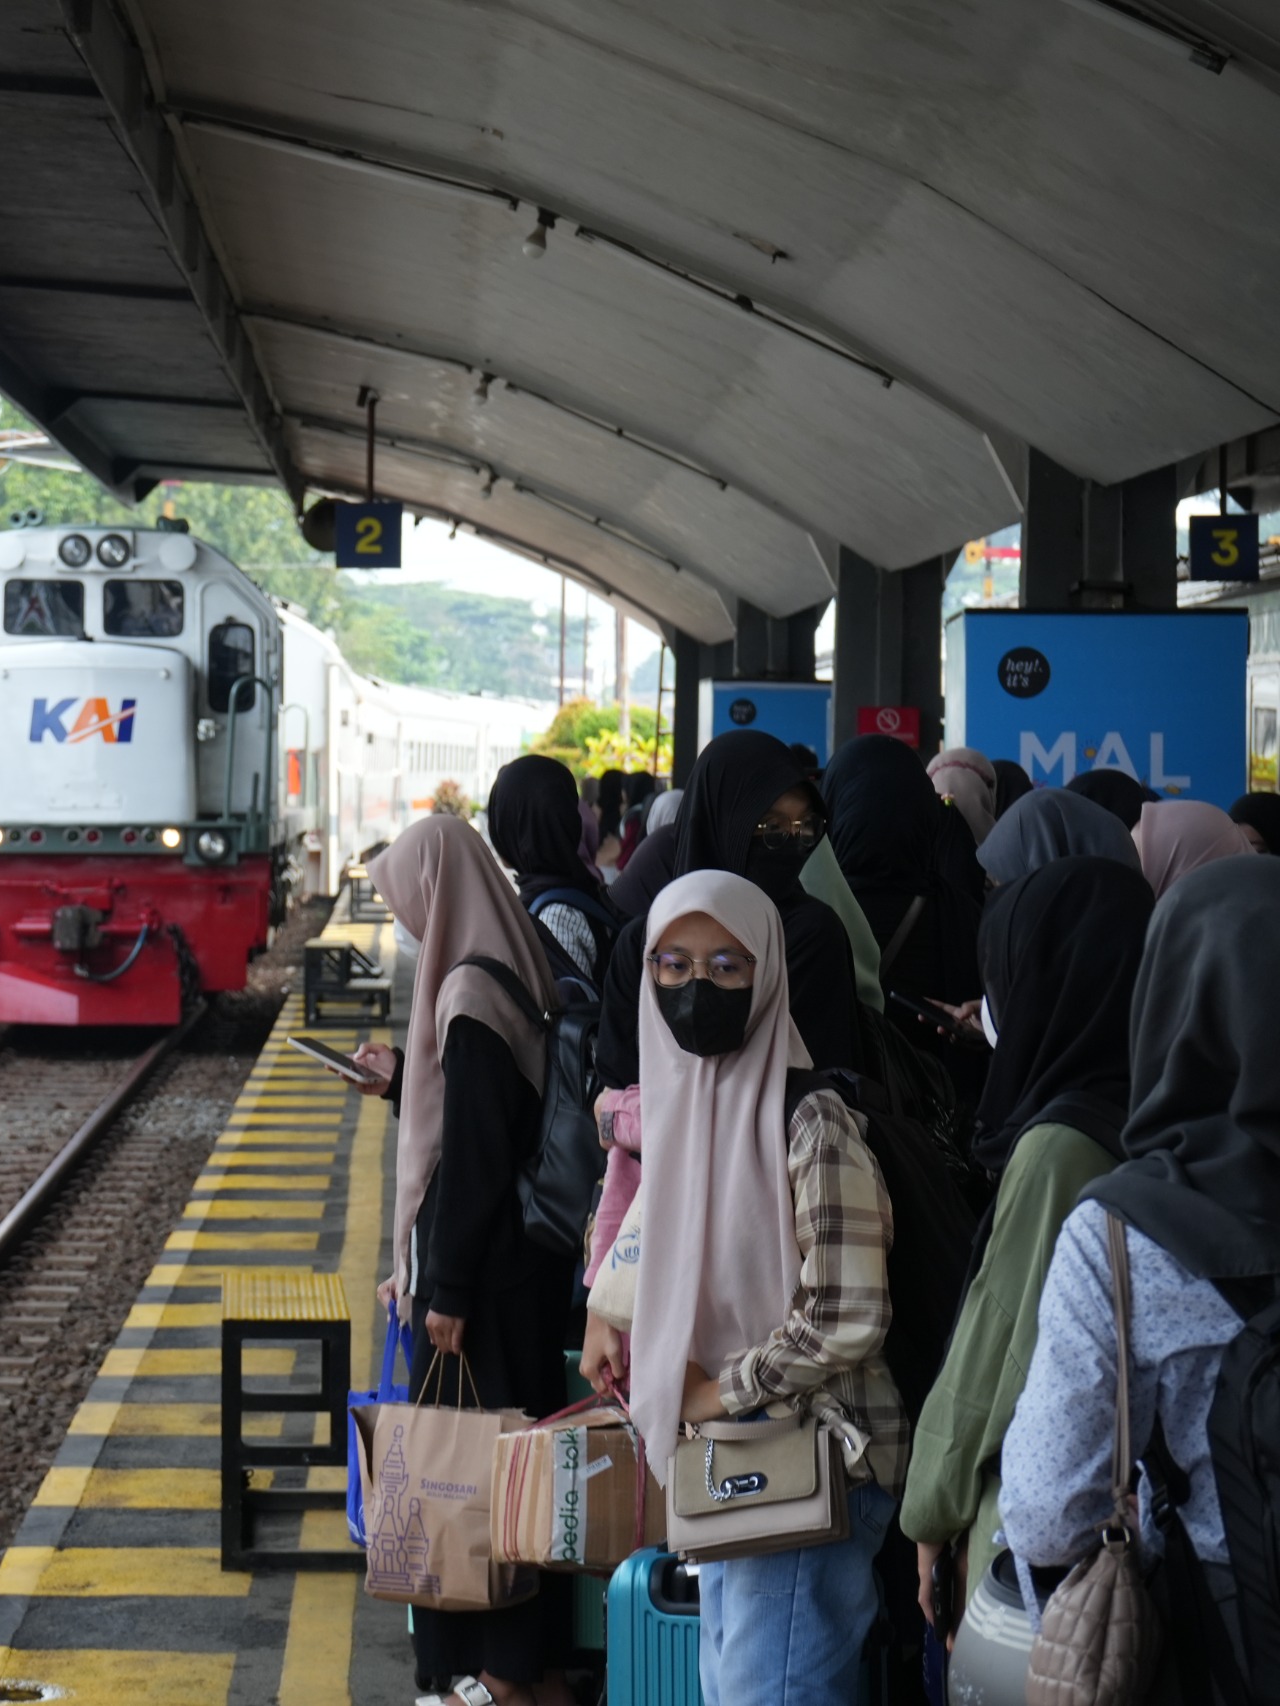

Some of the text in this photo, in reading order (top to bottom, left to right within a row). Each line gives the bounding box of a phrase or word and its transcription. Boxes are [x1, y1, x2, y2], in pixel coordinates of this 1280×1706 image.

[355, 516, 382, 553] 2
[1211, 529, 1239, 567] 3
[29, 697, 136, 742] KAI
[1020, 731, 1191, 788] MAL
[421, 1478, 477, 1495] SINGOSARI
